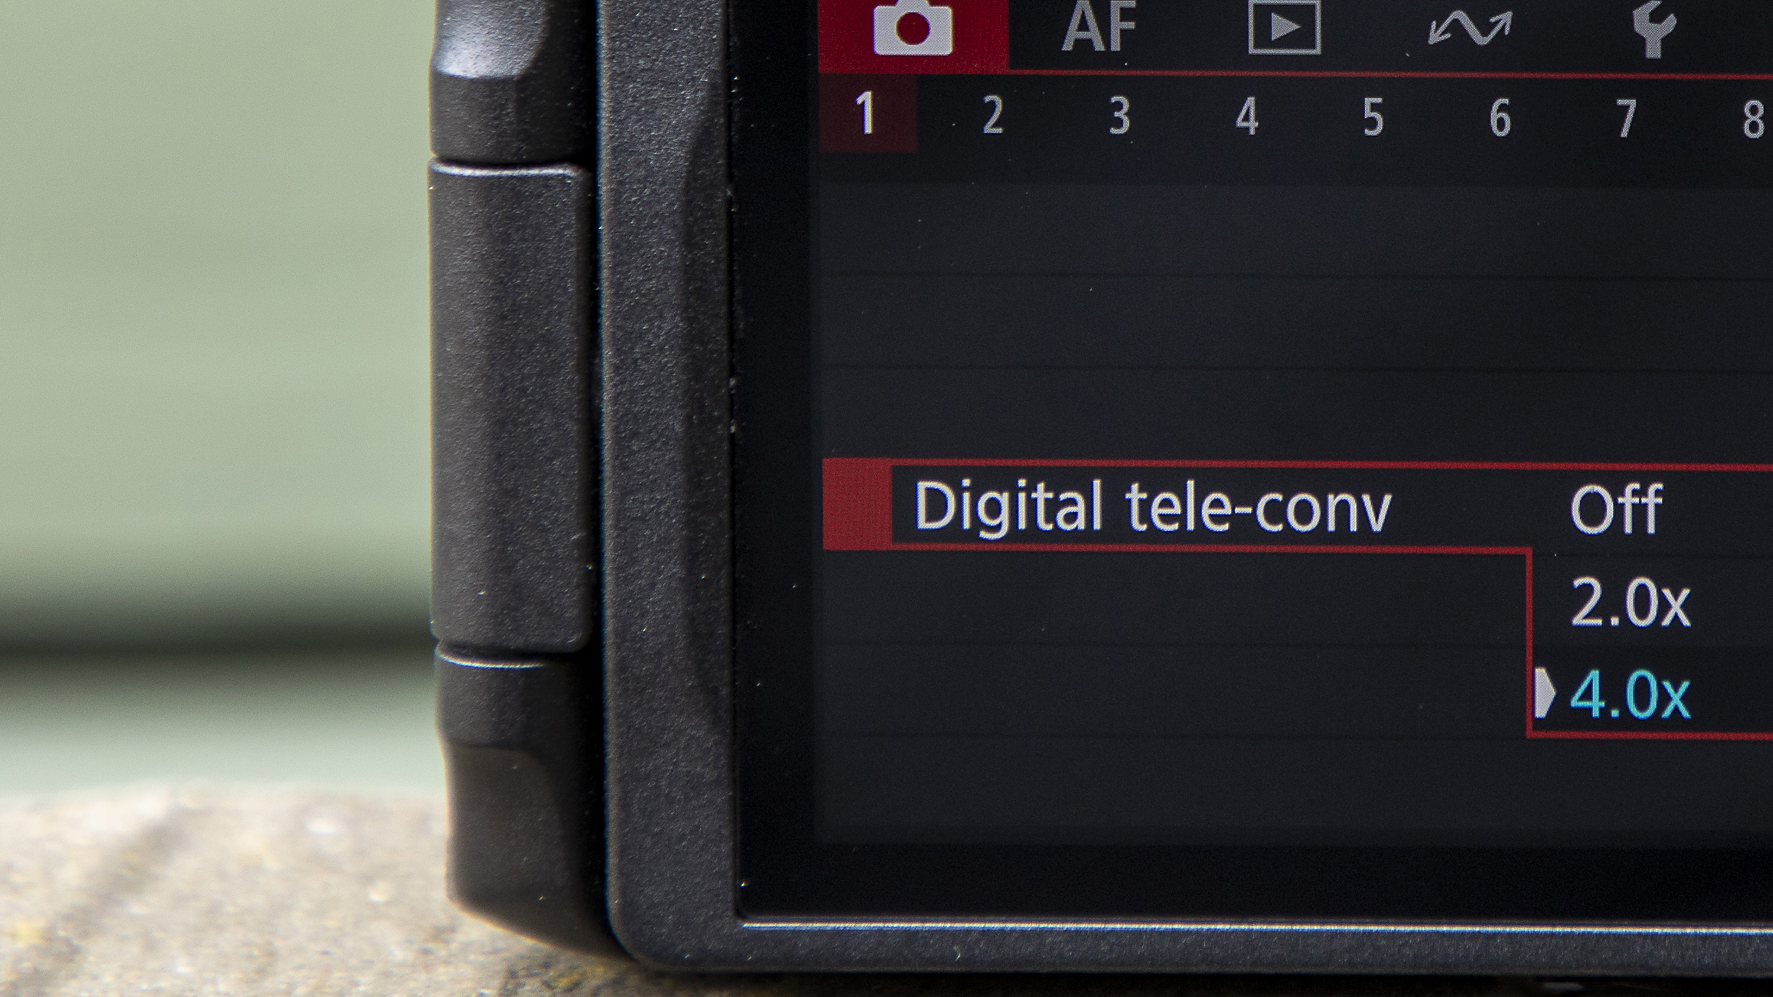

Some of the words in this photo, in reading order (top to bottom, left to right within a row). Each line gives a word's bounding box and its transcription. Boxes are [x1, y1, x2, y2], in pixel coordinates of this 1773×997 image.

[1060, 0, 1137, 52] AF
[855, 90, 873, 135] 1
[982, 95, 1003, 134] 2
[1109, 95, 1130, 135] 3
[1235, 96, 1259, 136] 4
[1363, 97, 1384, 136] 5
[1490, 98, 1511, 137] 6
[1616, 99, 1637, 138] 7
[1743, 100, 1765, 139] 8
[915, 478, 1101, 541] Digital
[1124, 479, 1392, 533] tele-conv
[1570, 482, 1664, 536] Off
[1571, 576, 1692, 628] 2.0x
[1570, 669, 1692, 720] 4.0x
